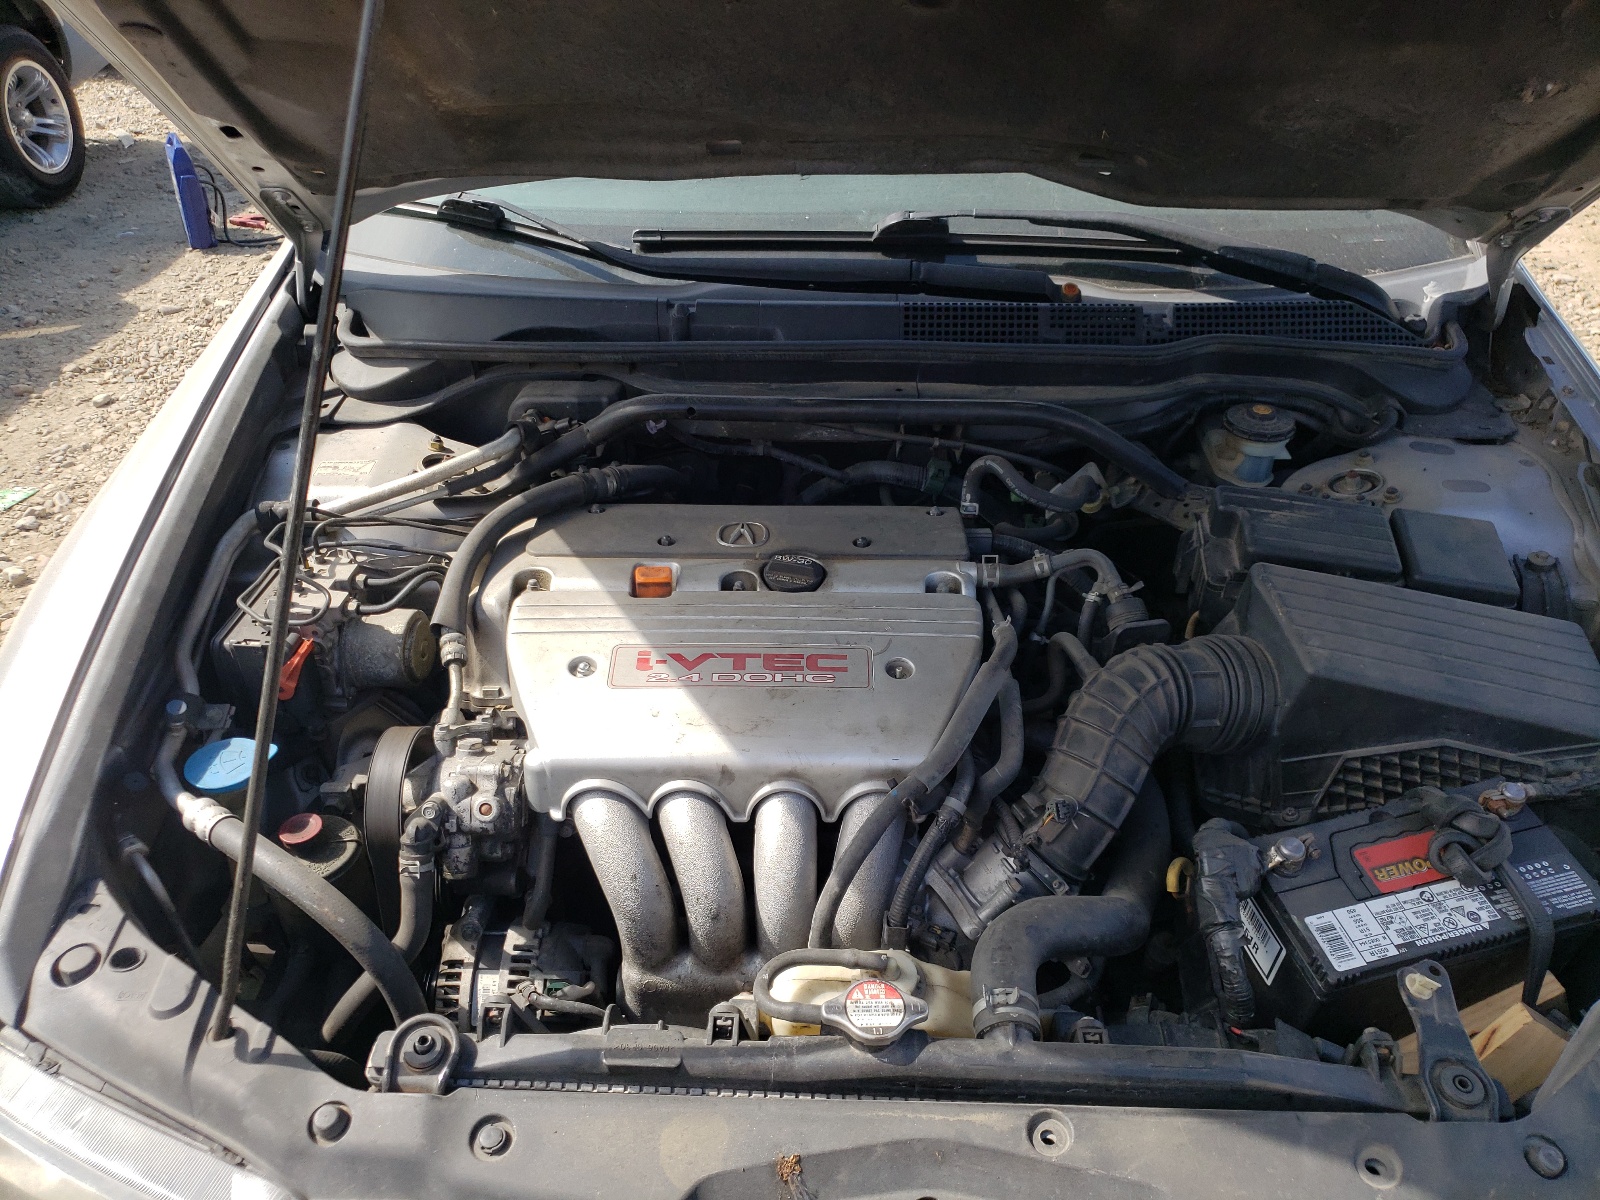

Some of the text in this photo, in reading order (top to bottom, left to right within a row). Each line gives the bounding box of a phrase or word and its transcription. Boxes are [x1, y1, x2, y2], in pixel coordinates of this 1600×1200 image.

[636, 650, 849, 672] i-VTEC
[646, 672, 837, 684] 2.4 DOHC
